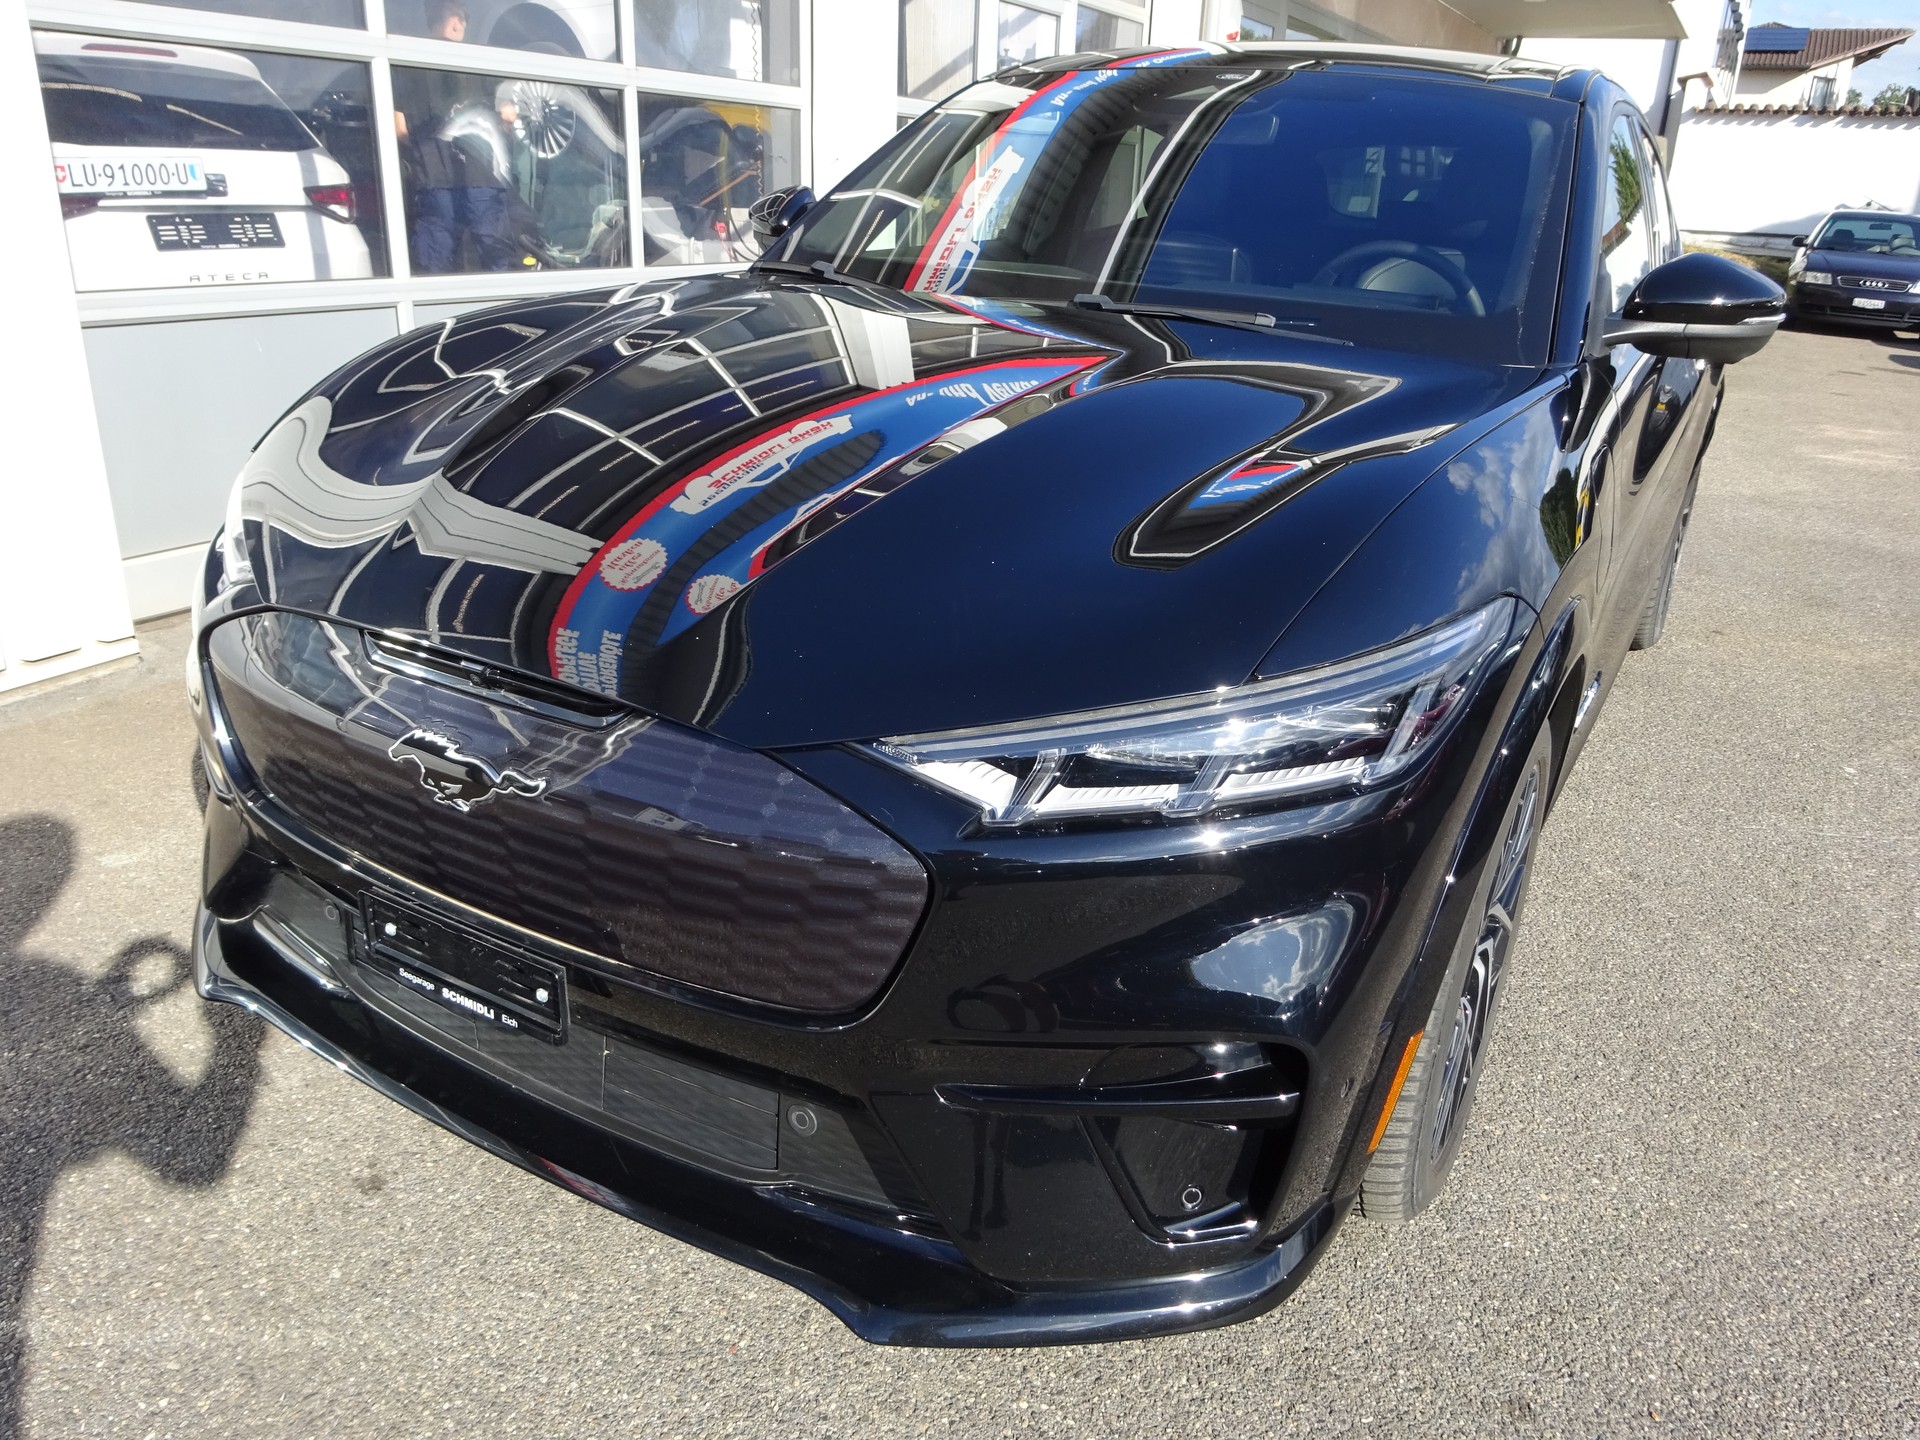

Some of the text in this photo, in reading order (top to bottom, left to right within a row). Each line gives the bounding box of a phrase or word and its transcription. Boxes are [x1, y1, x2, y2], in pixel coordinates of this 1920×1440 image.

[189, 272, 269, 283] ATECA
[399, 967, 518, 1028] Seegarage SCHMIDLI Eich
